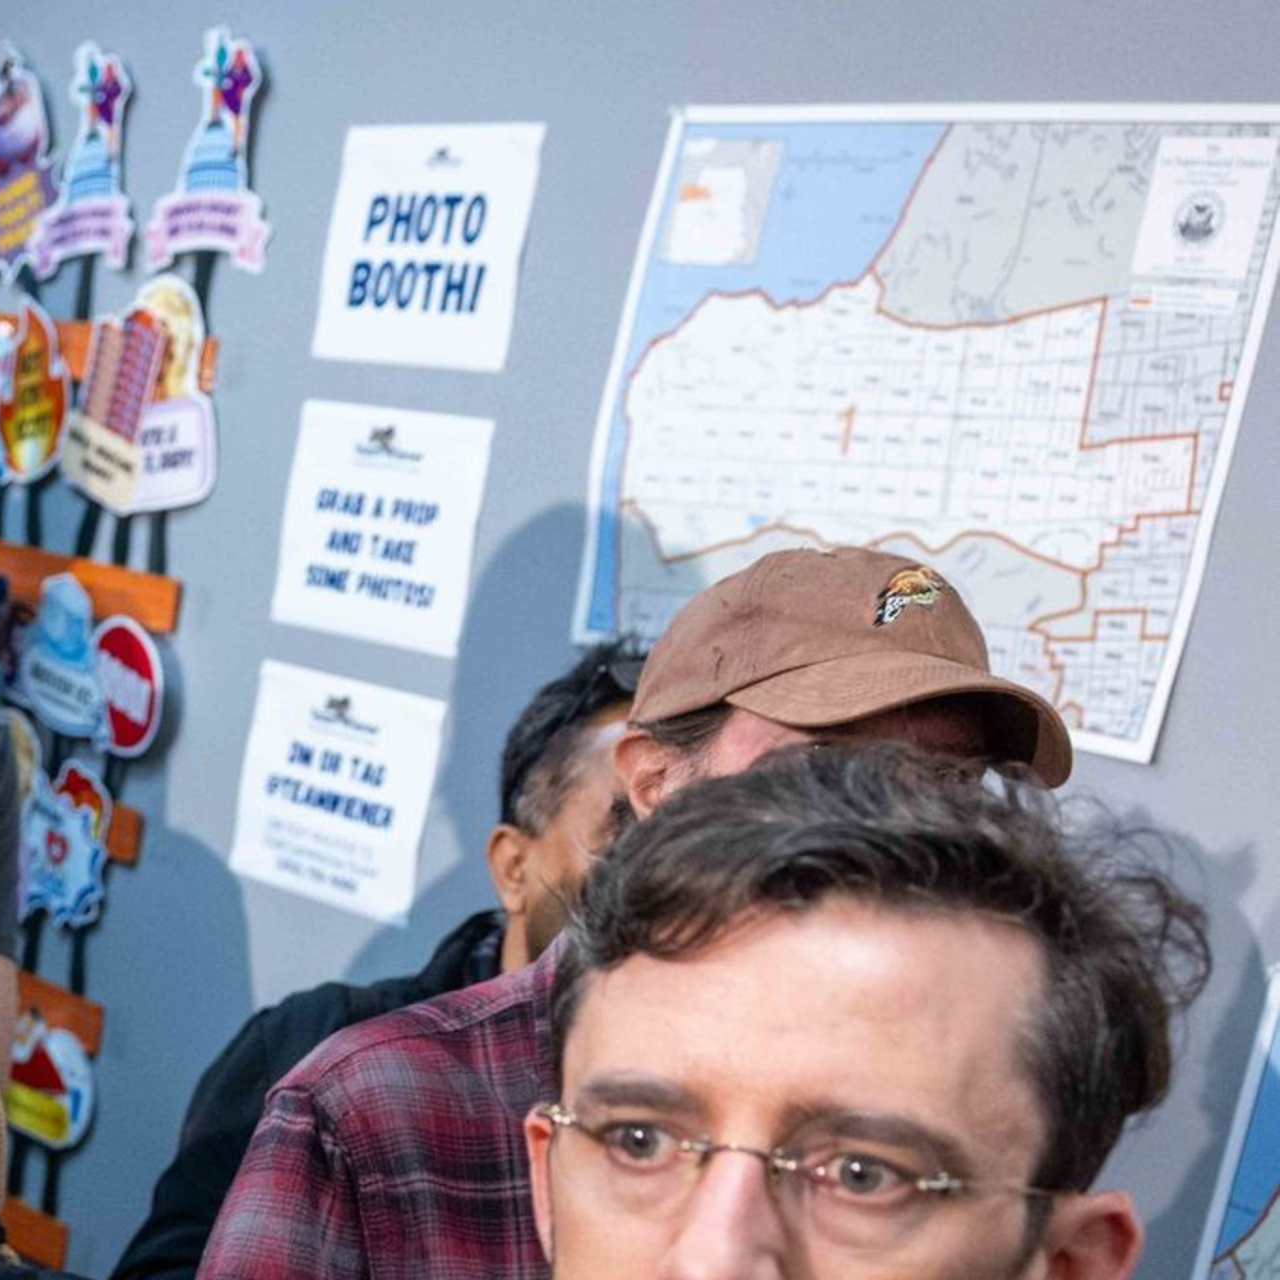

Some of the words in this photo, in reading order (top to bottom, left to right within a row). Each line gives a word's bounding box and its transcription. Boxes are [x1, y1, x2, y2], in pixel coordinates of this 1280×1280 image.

[364, 194, 487, 245] PHOTO
[346, 261, 486, 313] BOOTH!
[316, 488, 366, 517] GRAB
[371, 496, 385, 518] A
[391, 498, 440, 525] PROP
[326, 529, 361, 555] AND
[371, 535, 416, 564] TAKE
[306, 564, 349, 592] SOME
[289, 742, 312, 767] DM
[320, 749, 342, 773] OR
[351, 757, 386, 786] TAG
